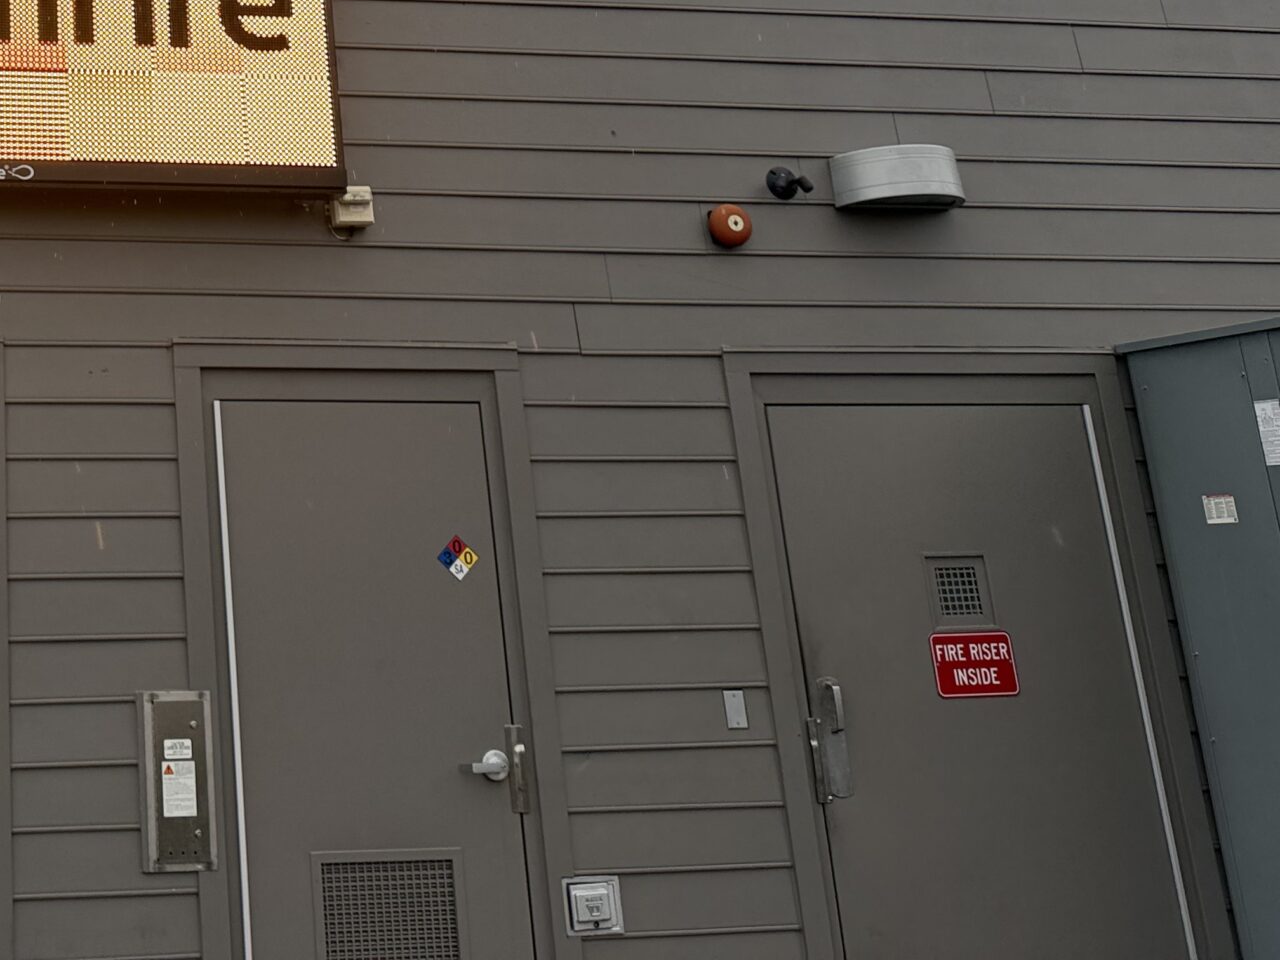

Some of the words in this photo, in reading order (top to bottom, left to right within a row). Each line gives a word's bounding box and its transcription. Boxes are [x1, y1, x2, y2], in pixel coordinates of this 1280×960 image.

[453, 540, 462, 553] 0
[464, 551, 473, 565] 0
[935, 644, 966, 662] FIRE
[969, 643, 1009, 661] RISER
[953, 668, 1000, 686] INSIDE
